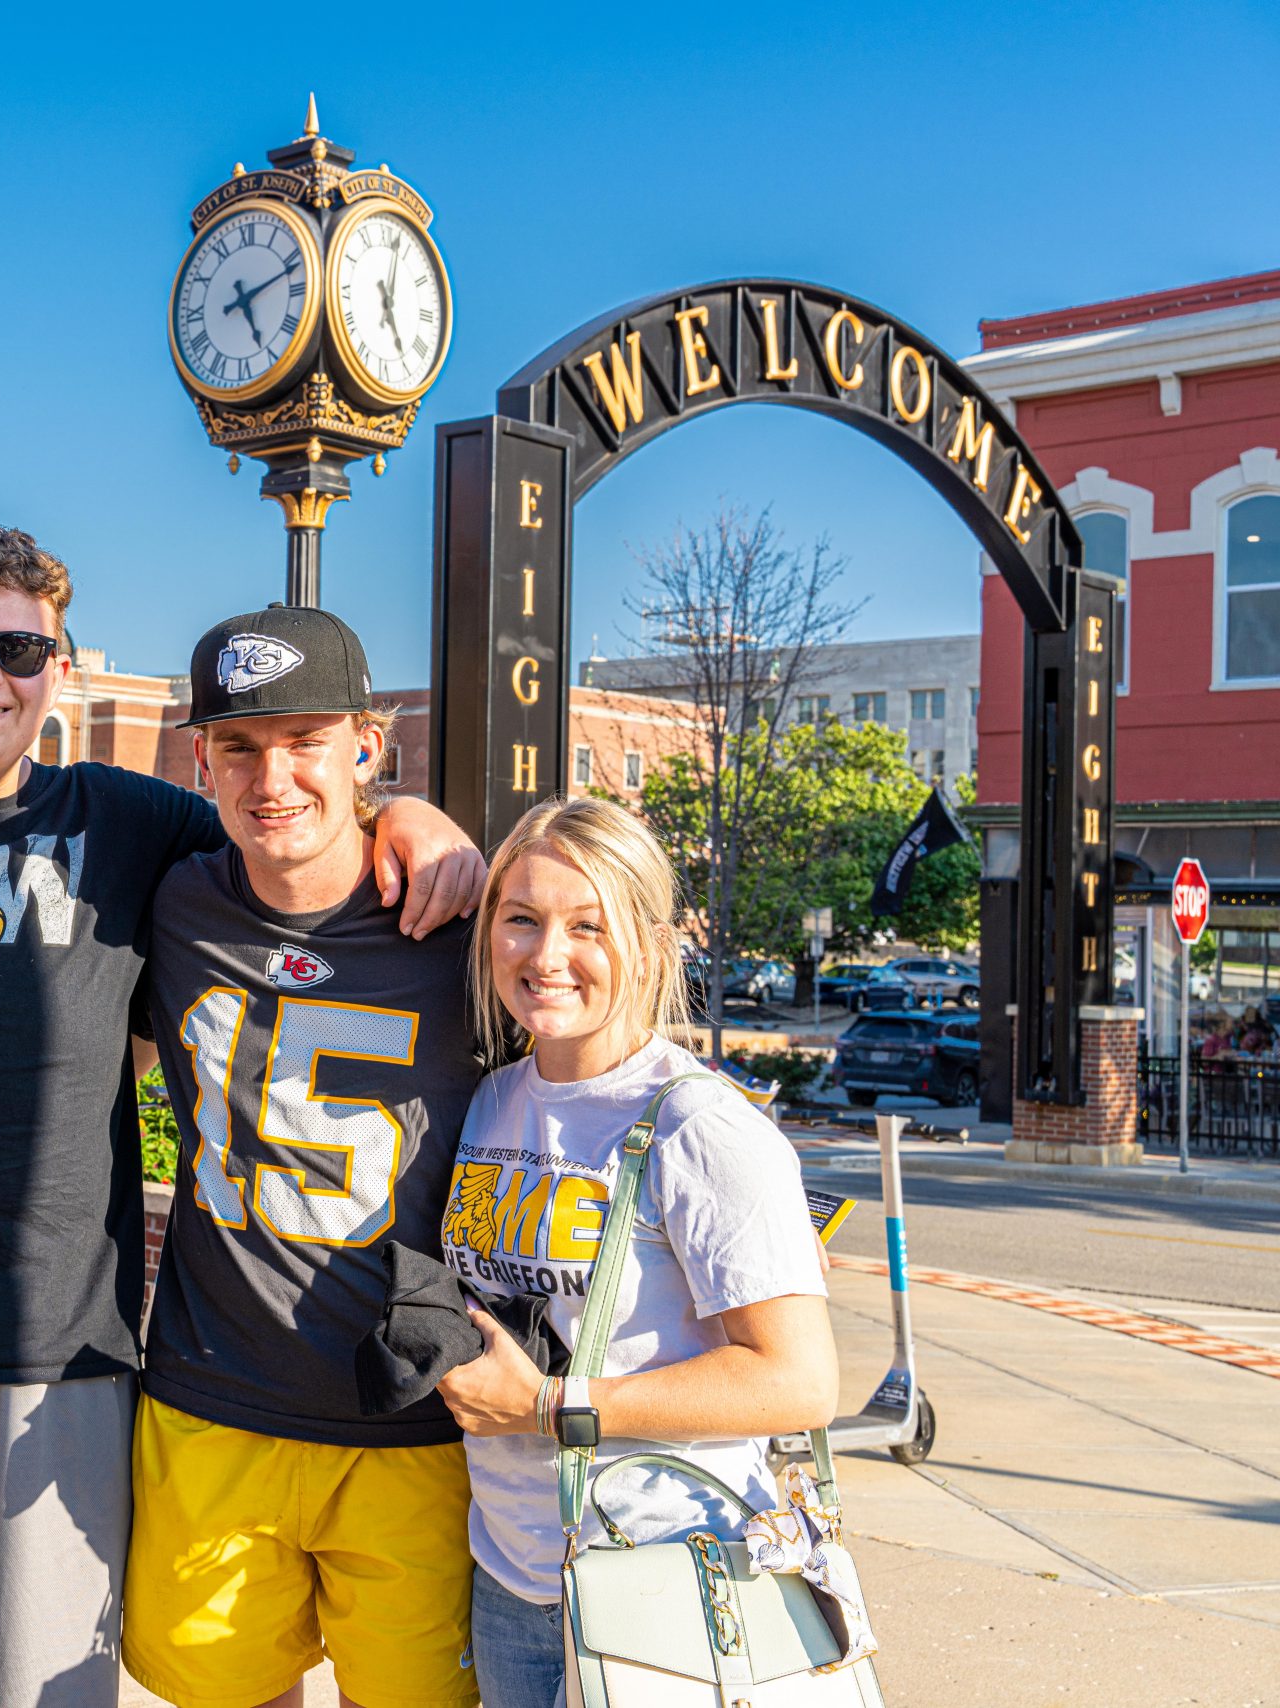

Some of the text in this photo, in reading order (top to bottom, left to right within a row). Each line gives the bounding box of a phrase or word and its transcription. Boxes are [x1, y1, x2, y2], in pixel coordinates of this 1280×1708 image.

[195, 175, 300, 221] CITY OF ST. JOSEPH
[345, 176, 429, 225] CITY OF ST. JOSEPH
[583, 298, 1042, 545] WELCOME
[235, 643, 283, 674] KC
[1082, 615, 1103, 972] EIGHTH
[1174, 884, 1206, 917] STOP
[282, 954, 317, 981] KC
[180, 986, 420, 1247] 15
[459, 1143, 486, 1158] SOURI
[475, 1254, 596, 1297] GRIFFON
